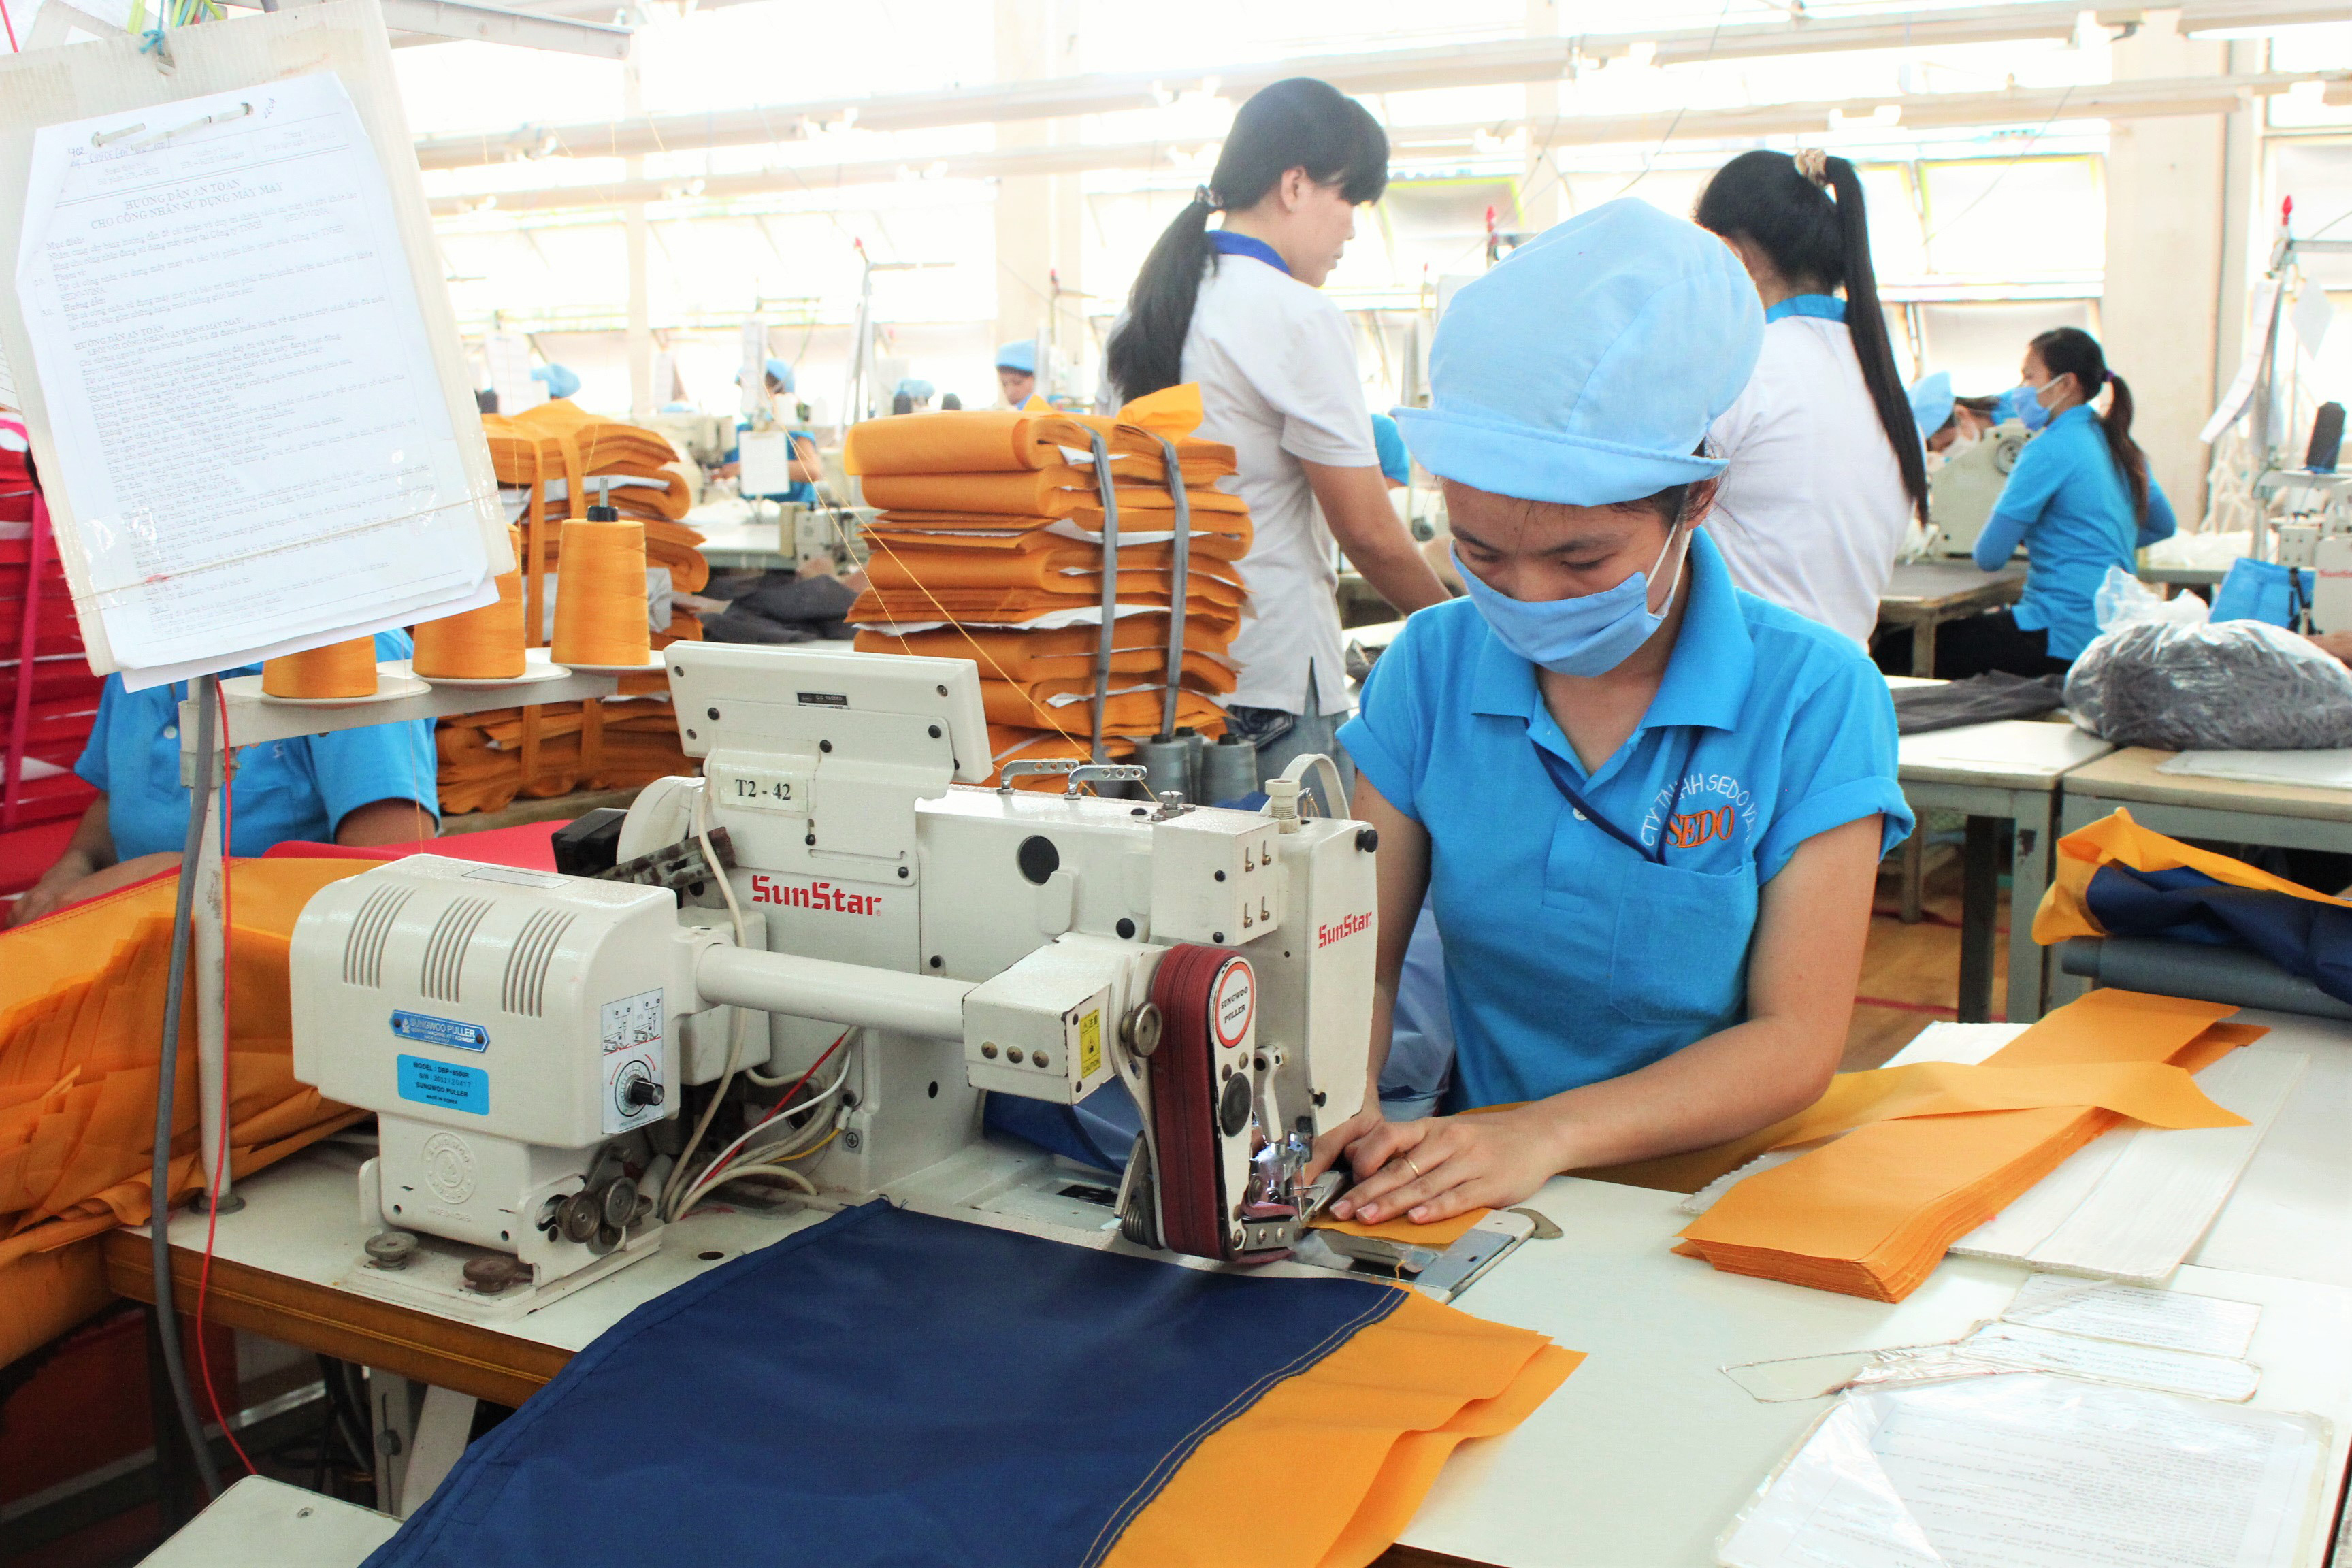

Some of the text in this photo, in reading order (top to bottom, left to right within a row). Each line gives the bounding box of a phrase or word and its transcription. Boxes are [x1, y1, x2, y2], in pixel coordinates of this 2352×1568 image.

[735, 777, 757, 798] T2
[772, 783, 791, 801] 42
[1642, 806, 1661, 847] CTY
[1706, 774, 1750, 806] SEDO
[1666, 804, 1735, 849] SEDO
[751, 874, 883, 916] SunStar
[1318, 911, 1372, 949] SunStar
[1221, 986, 1249, 1009] SUNGWOO
[1224, 1004, 1246, 1024] PULLER
[447, 1025, 476, 1039] PULLER
[413, 1062, 432, 1071] MODEL
[419, 1072, 429, 1080] S/N
[416, 1081, 468, 1097] SUNGWOO PULLER
